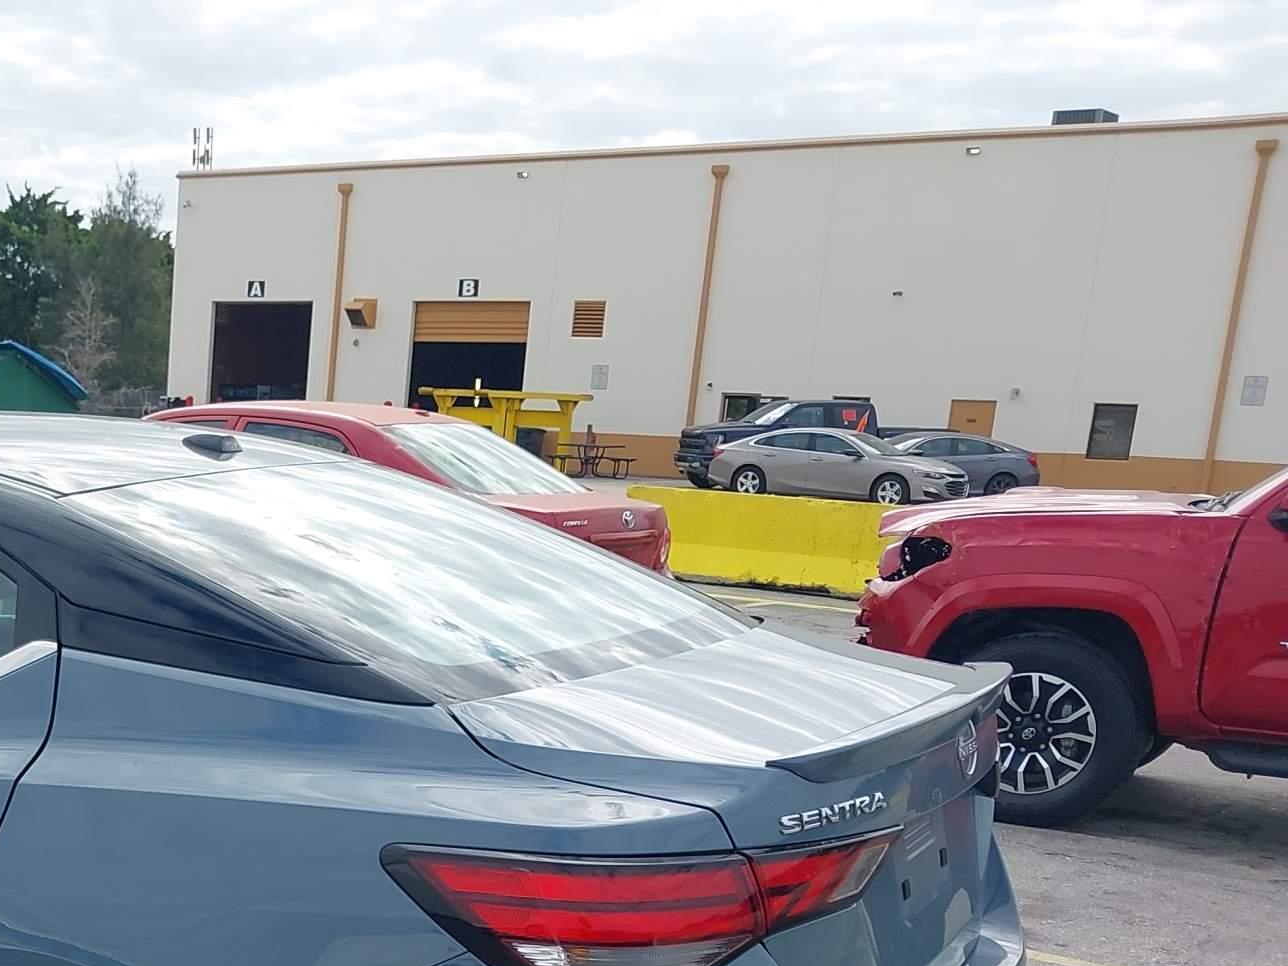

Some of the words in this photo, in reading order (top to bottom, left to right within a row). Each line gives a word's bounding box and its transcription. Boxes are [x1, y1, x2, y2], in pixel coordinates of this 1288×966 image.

[249, 281, 263, 297] A
[462, 280, 476, 296] B
[779, 791, 888, 836] SENTRA
